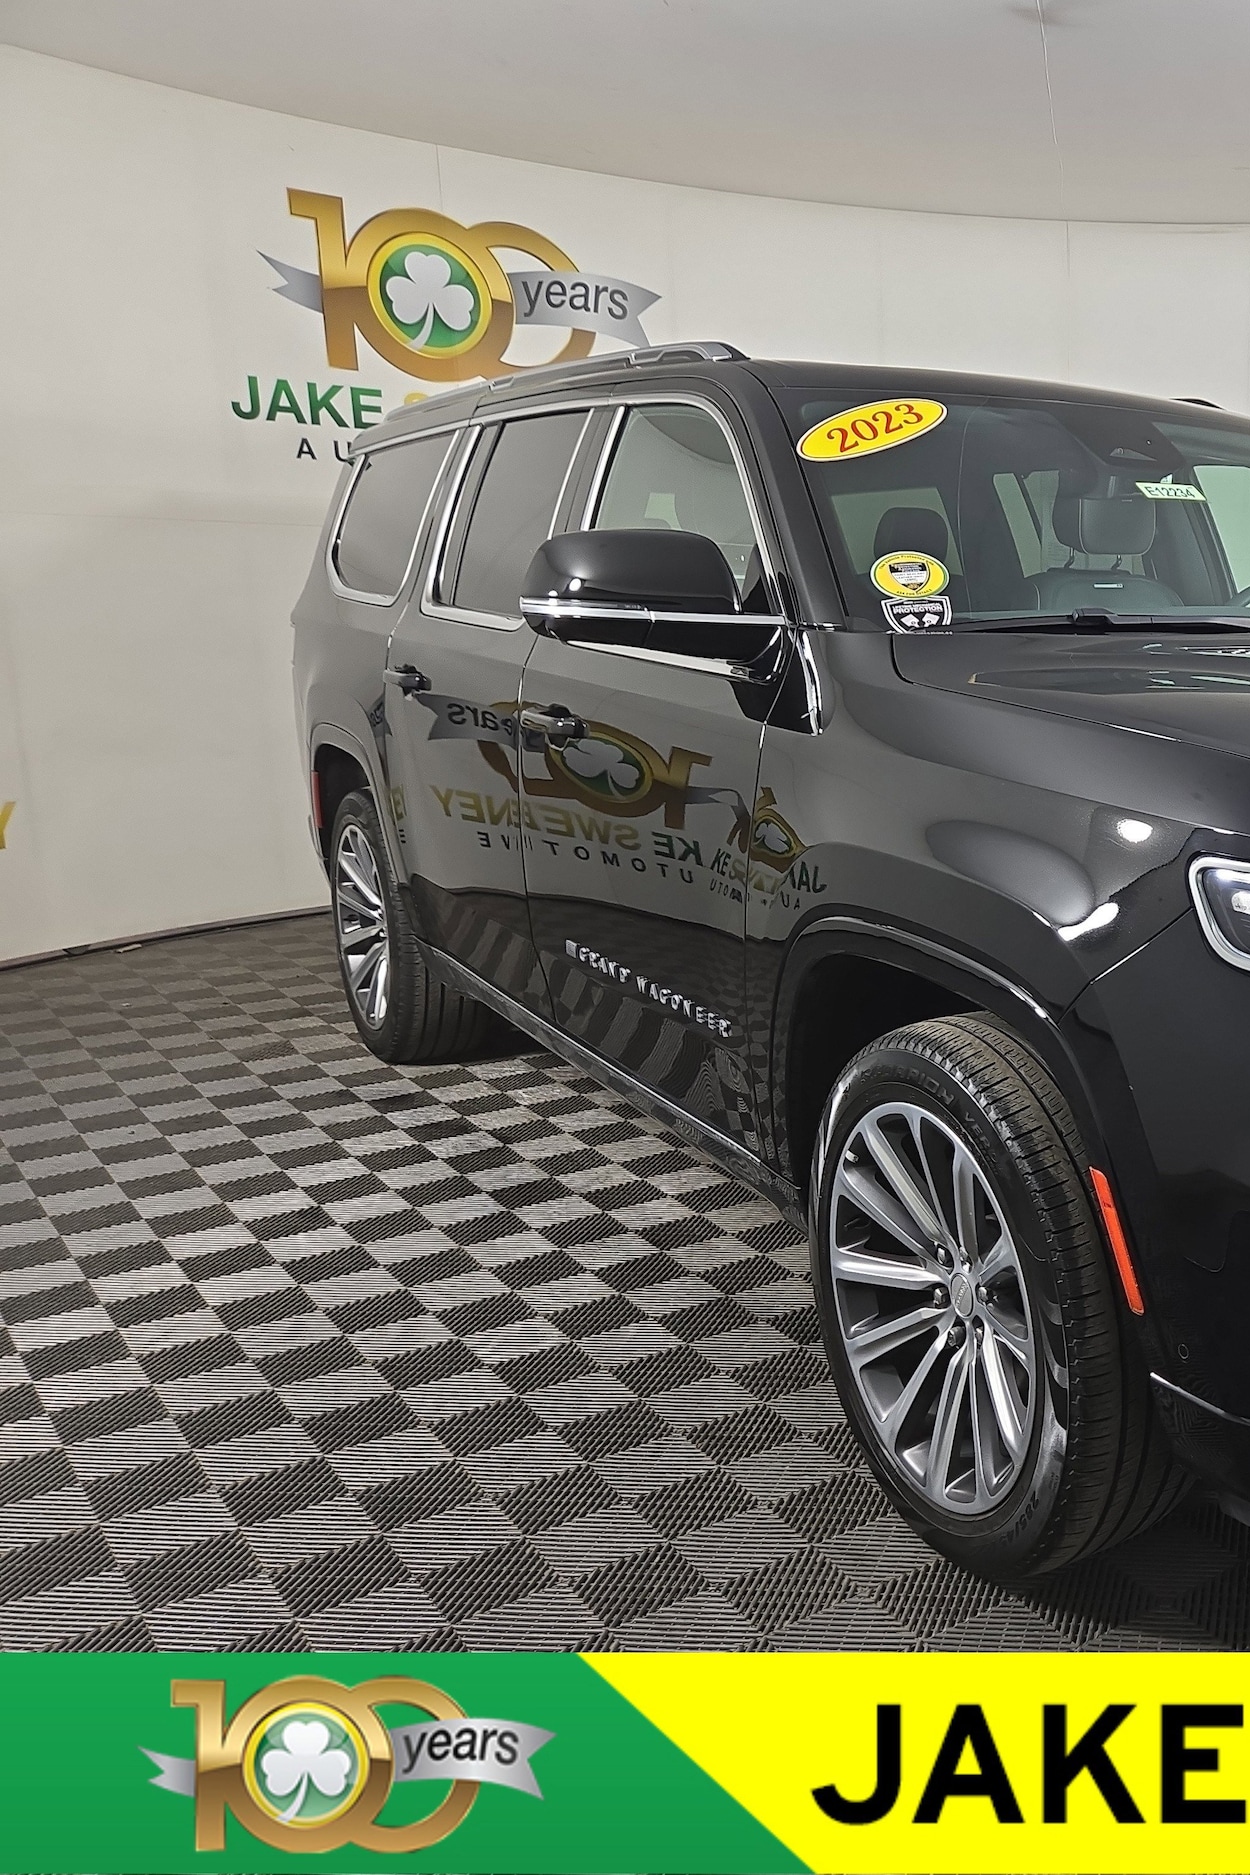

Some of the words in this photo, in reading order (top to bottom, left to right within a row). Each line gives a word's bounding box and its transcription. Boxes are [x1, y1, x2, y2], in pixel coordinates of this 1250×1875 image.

[520, 273, 630, 321] years
[231, 375, 382, 429] JAKE
[827, 403, 924, 453] 2023
[578, 946, 631, 983] GRAND
[636, 975, 733, 1037] WAGONEER
